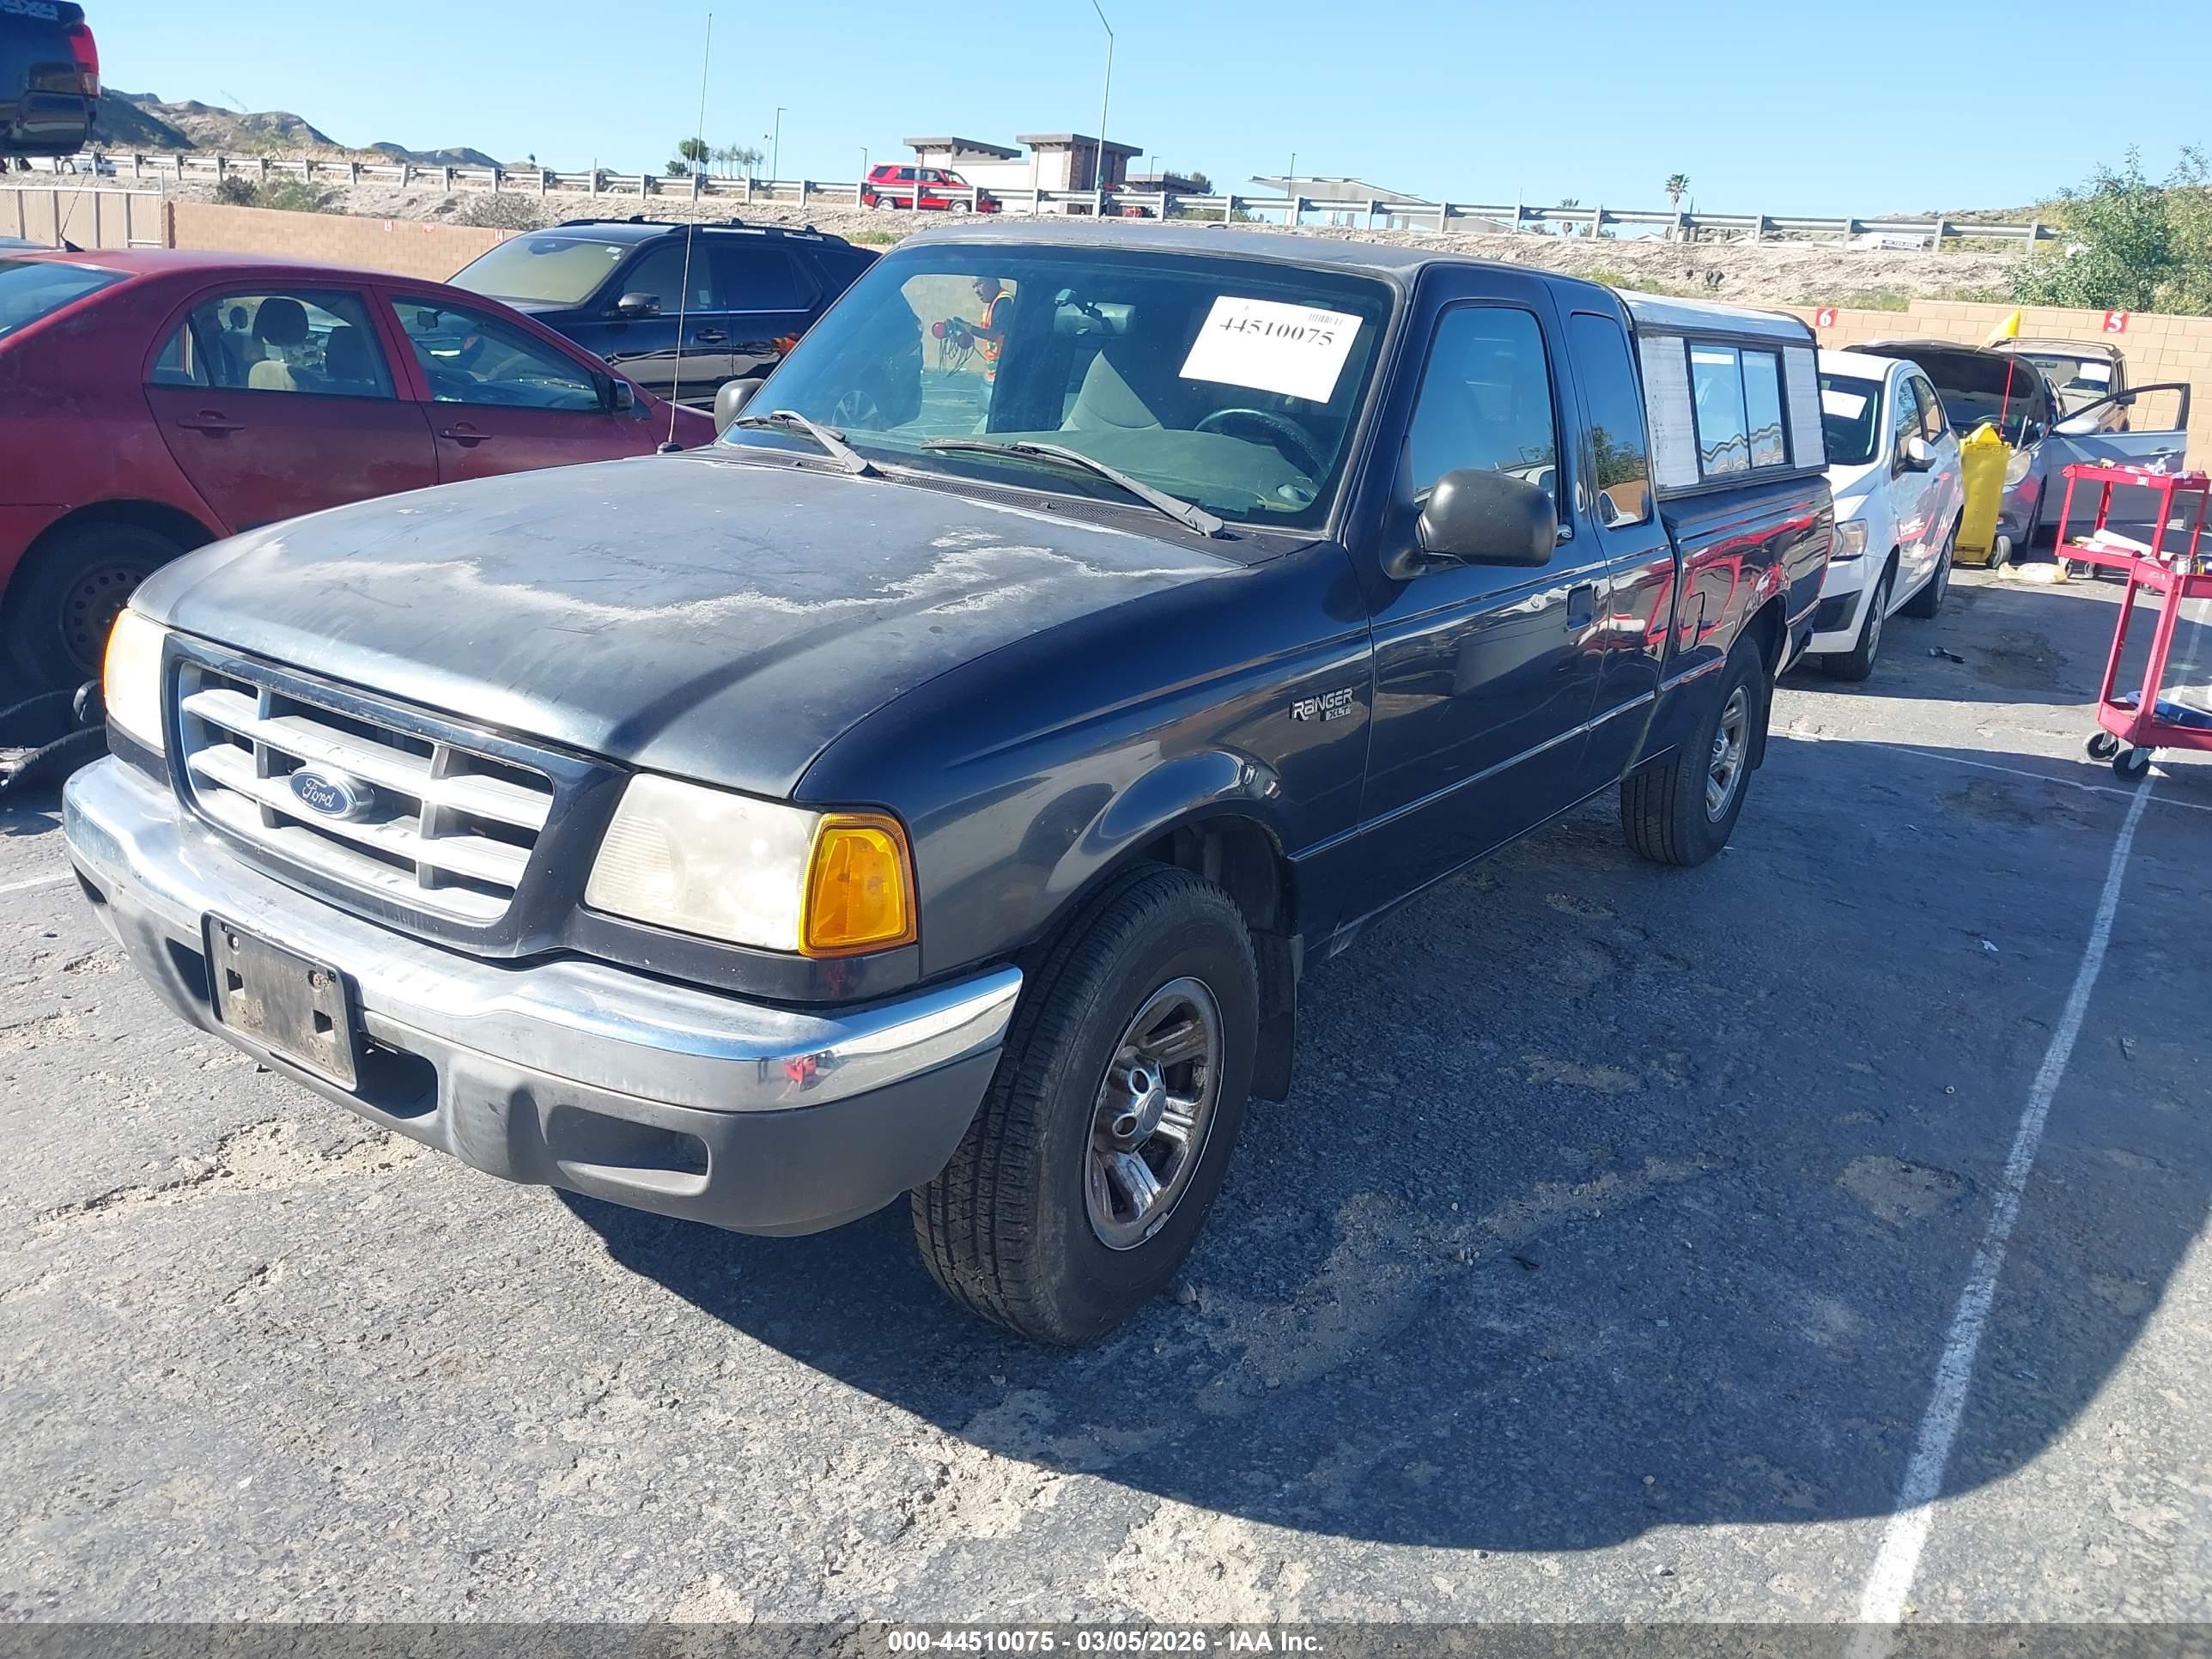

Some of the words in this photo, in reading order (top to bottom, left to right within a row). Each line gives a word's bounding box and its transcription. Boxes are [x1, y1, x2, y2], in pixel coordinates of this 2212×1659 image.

[1219, 317, 1335, 346] 44510075
[1819, 309, 1832, 327] 6
[2107, 313, 2123, 332] 5
[1291, 688, 1353, 721] RANGER
[302, 777, 336, 807] Ford
